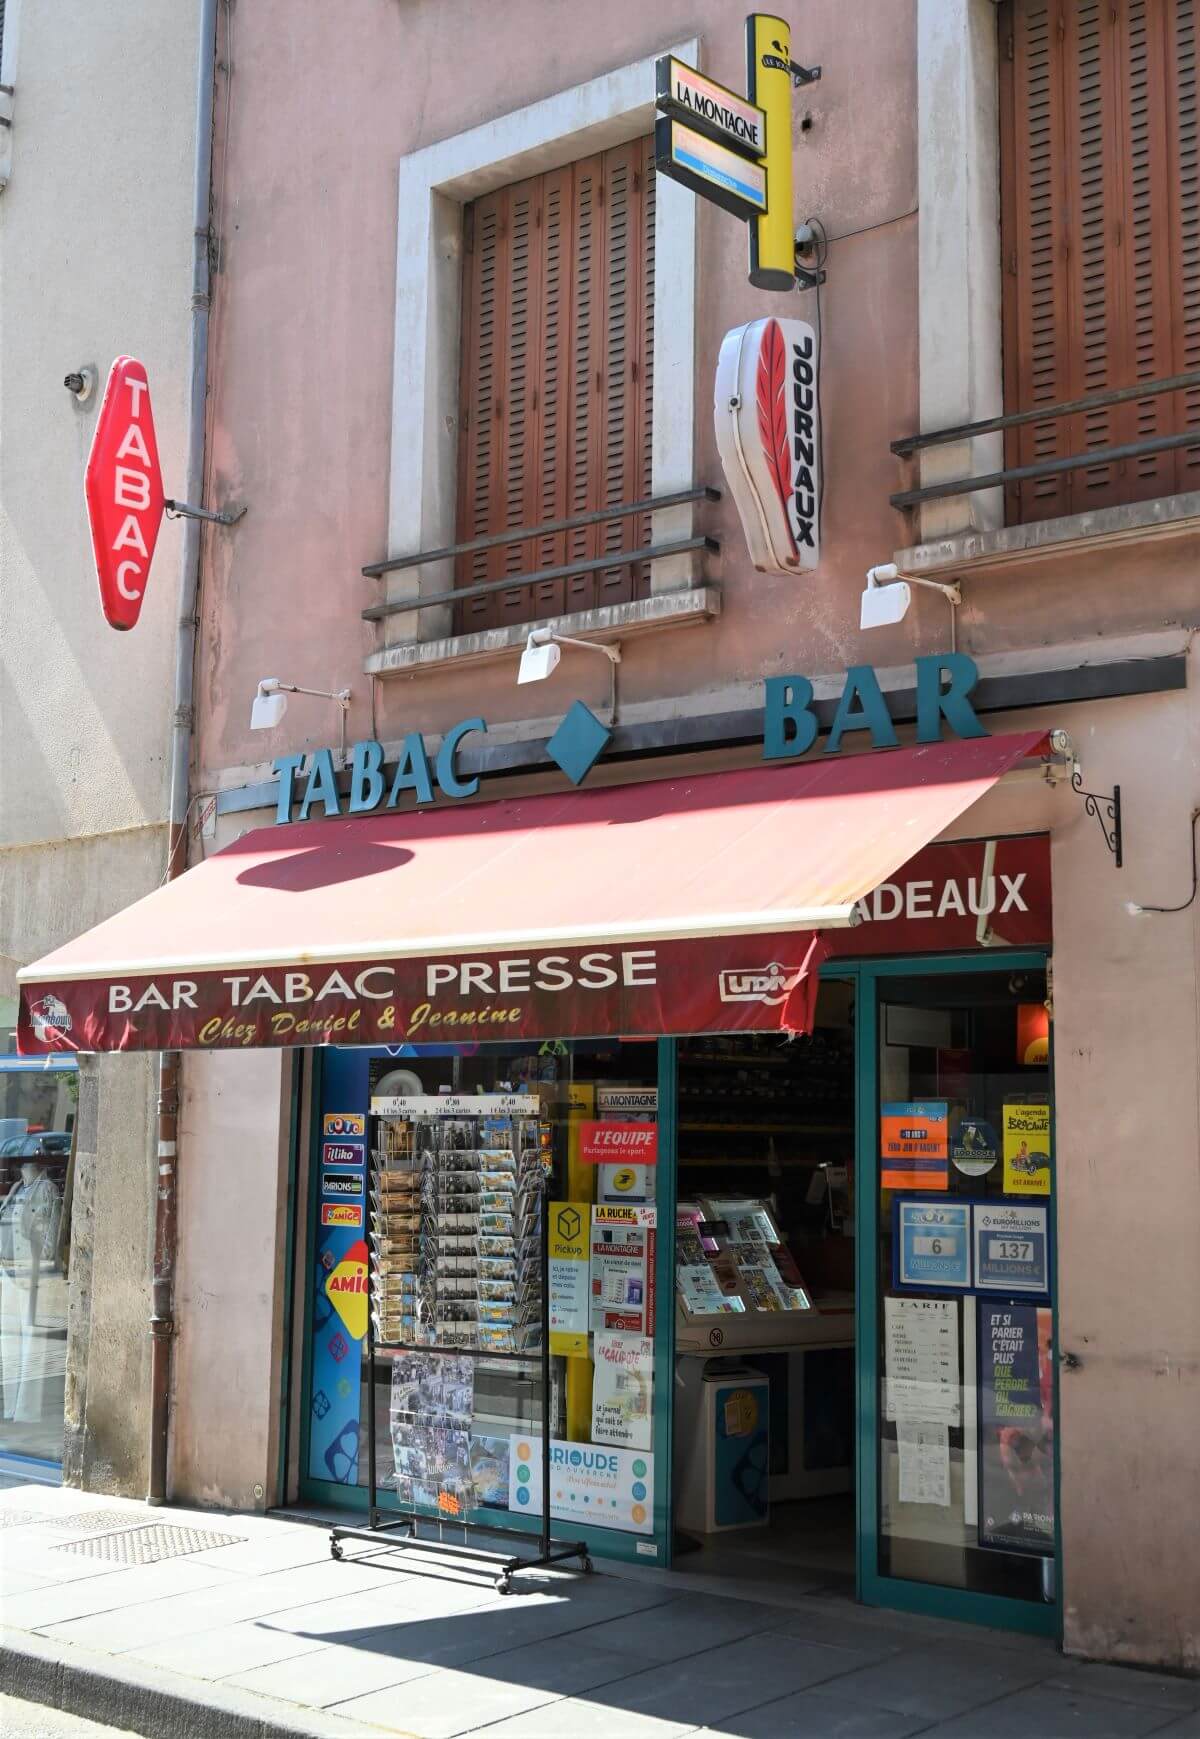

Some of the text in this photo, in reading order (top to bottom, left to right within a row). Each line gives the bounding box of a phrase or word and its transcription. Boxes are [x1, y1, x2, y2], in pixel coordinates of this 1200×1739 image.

[677, 81, 758, 145] LA MONTAGNE
[793, 337, 815, 547] JOURNAUX
[112, 376, 152, 600] TABAC
[762, 652, 992, 760] BAR
[273, 717, 488, 825] TABAC
[109, 950, 657, 1013] BAR TABAC PRESSE
[198, 1003, 521, 1044] Chez Daniel & Jeanine
[599, 1096, 656, 1105] LA MONTAGNE
[328, 1147, 353, 1161] illiko
[324, 1182, 352, 1192] PARIONS
[596, 1208, 633, 1218] LA RUCHE
[993, 1218, 1040, 1227] EUROMILLIONS
[554, 1245, 582, 1255] Pickup
[931, 1238, 942, 1255] 6
[999, 1242, 1029, 1259] 137
[990, 1314, 1011, 1326] ET SI
[991, 1327, 1023, 1339] PARIER
[993, 1352, 1015, 1364] PLUS
[994, 1365, 1012, 1377] QUE
[994, 1378, 1029, 1391] PERDRE
